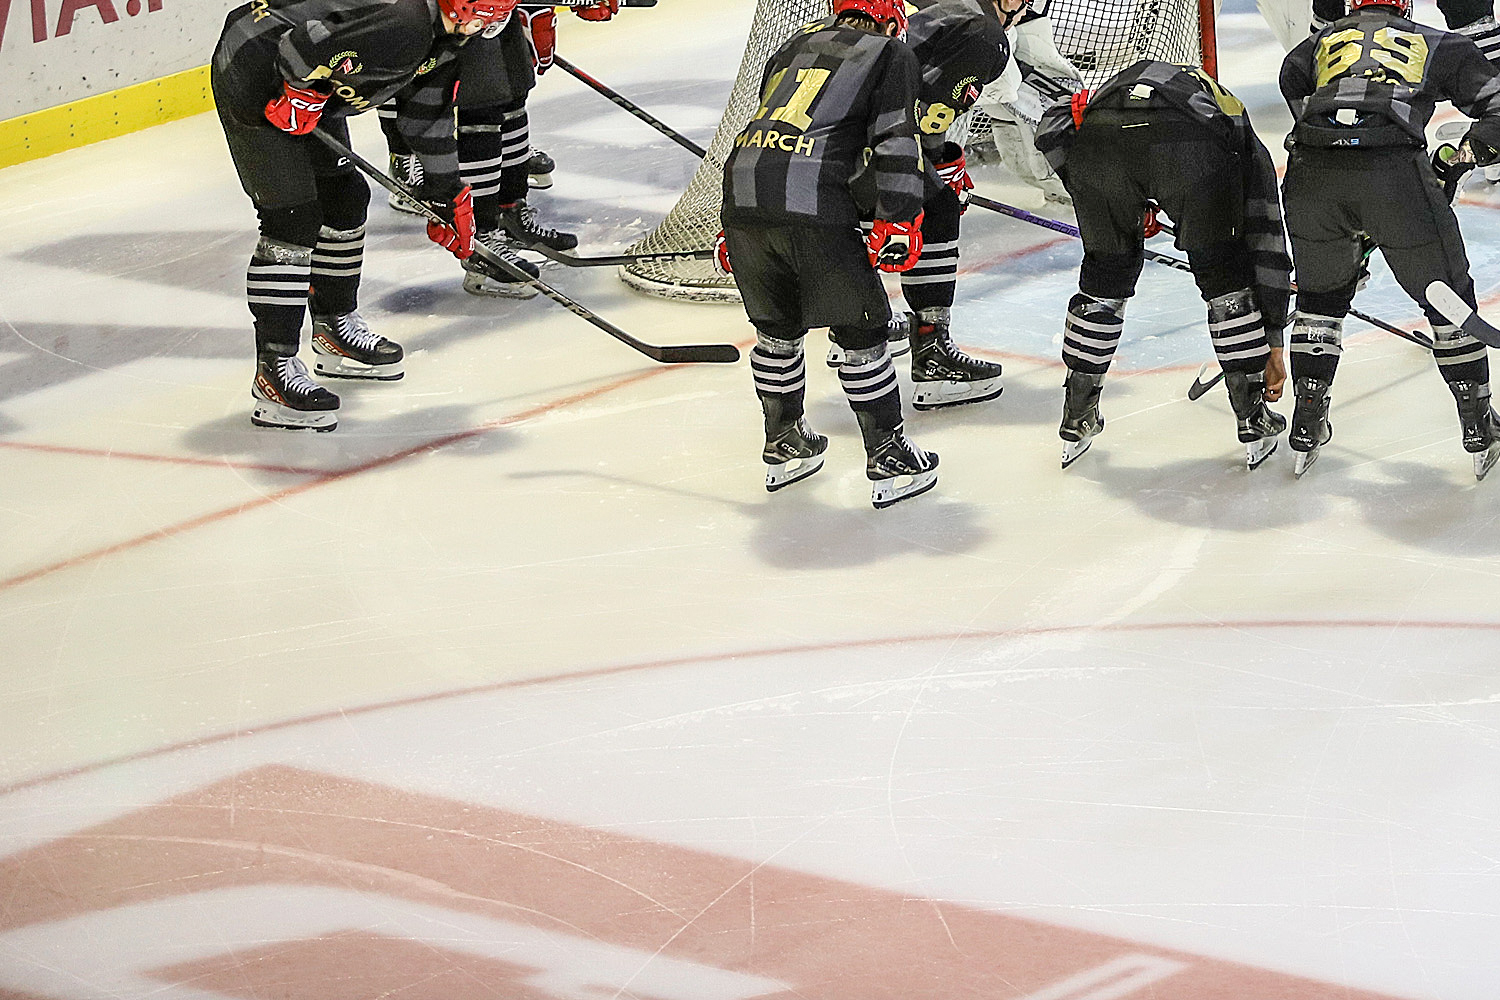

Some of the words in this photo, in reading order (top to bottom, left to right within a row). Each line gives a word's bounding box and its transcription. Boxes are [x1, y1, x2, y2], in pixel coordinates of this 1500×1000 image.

[1315, 27, 1429, 88] 69
[291, 98, 326, 113] CC
[734, 129, 817, 157] MARCH
[636, 254, 697, 267] CCM
[1153, 255, 1191, 271] CC
[1081, 419, 1091, 432] CC
